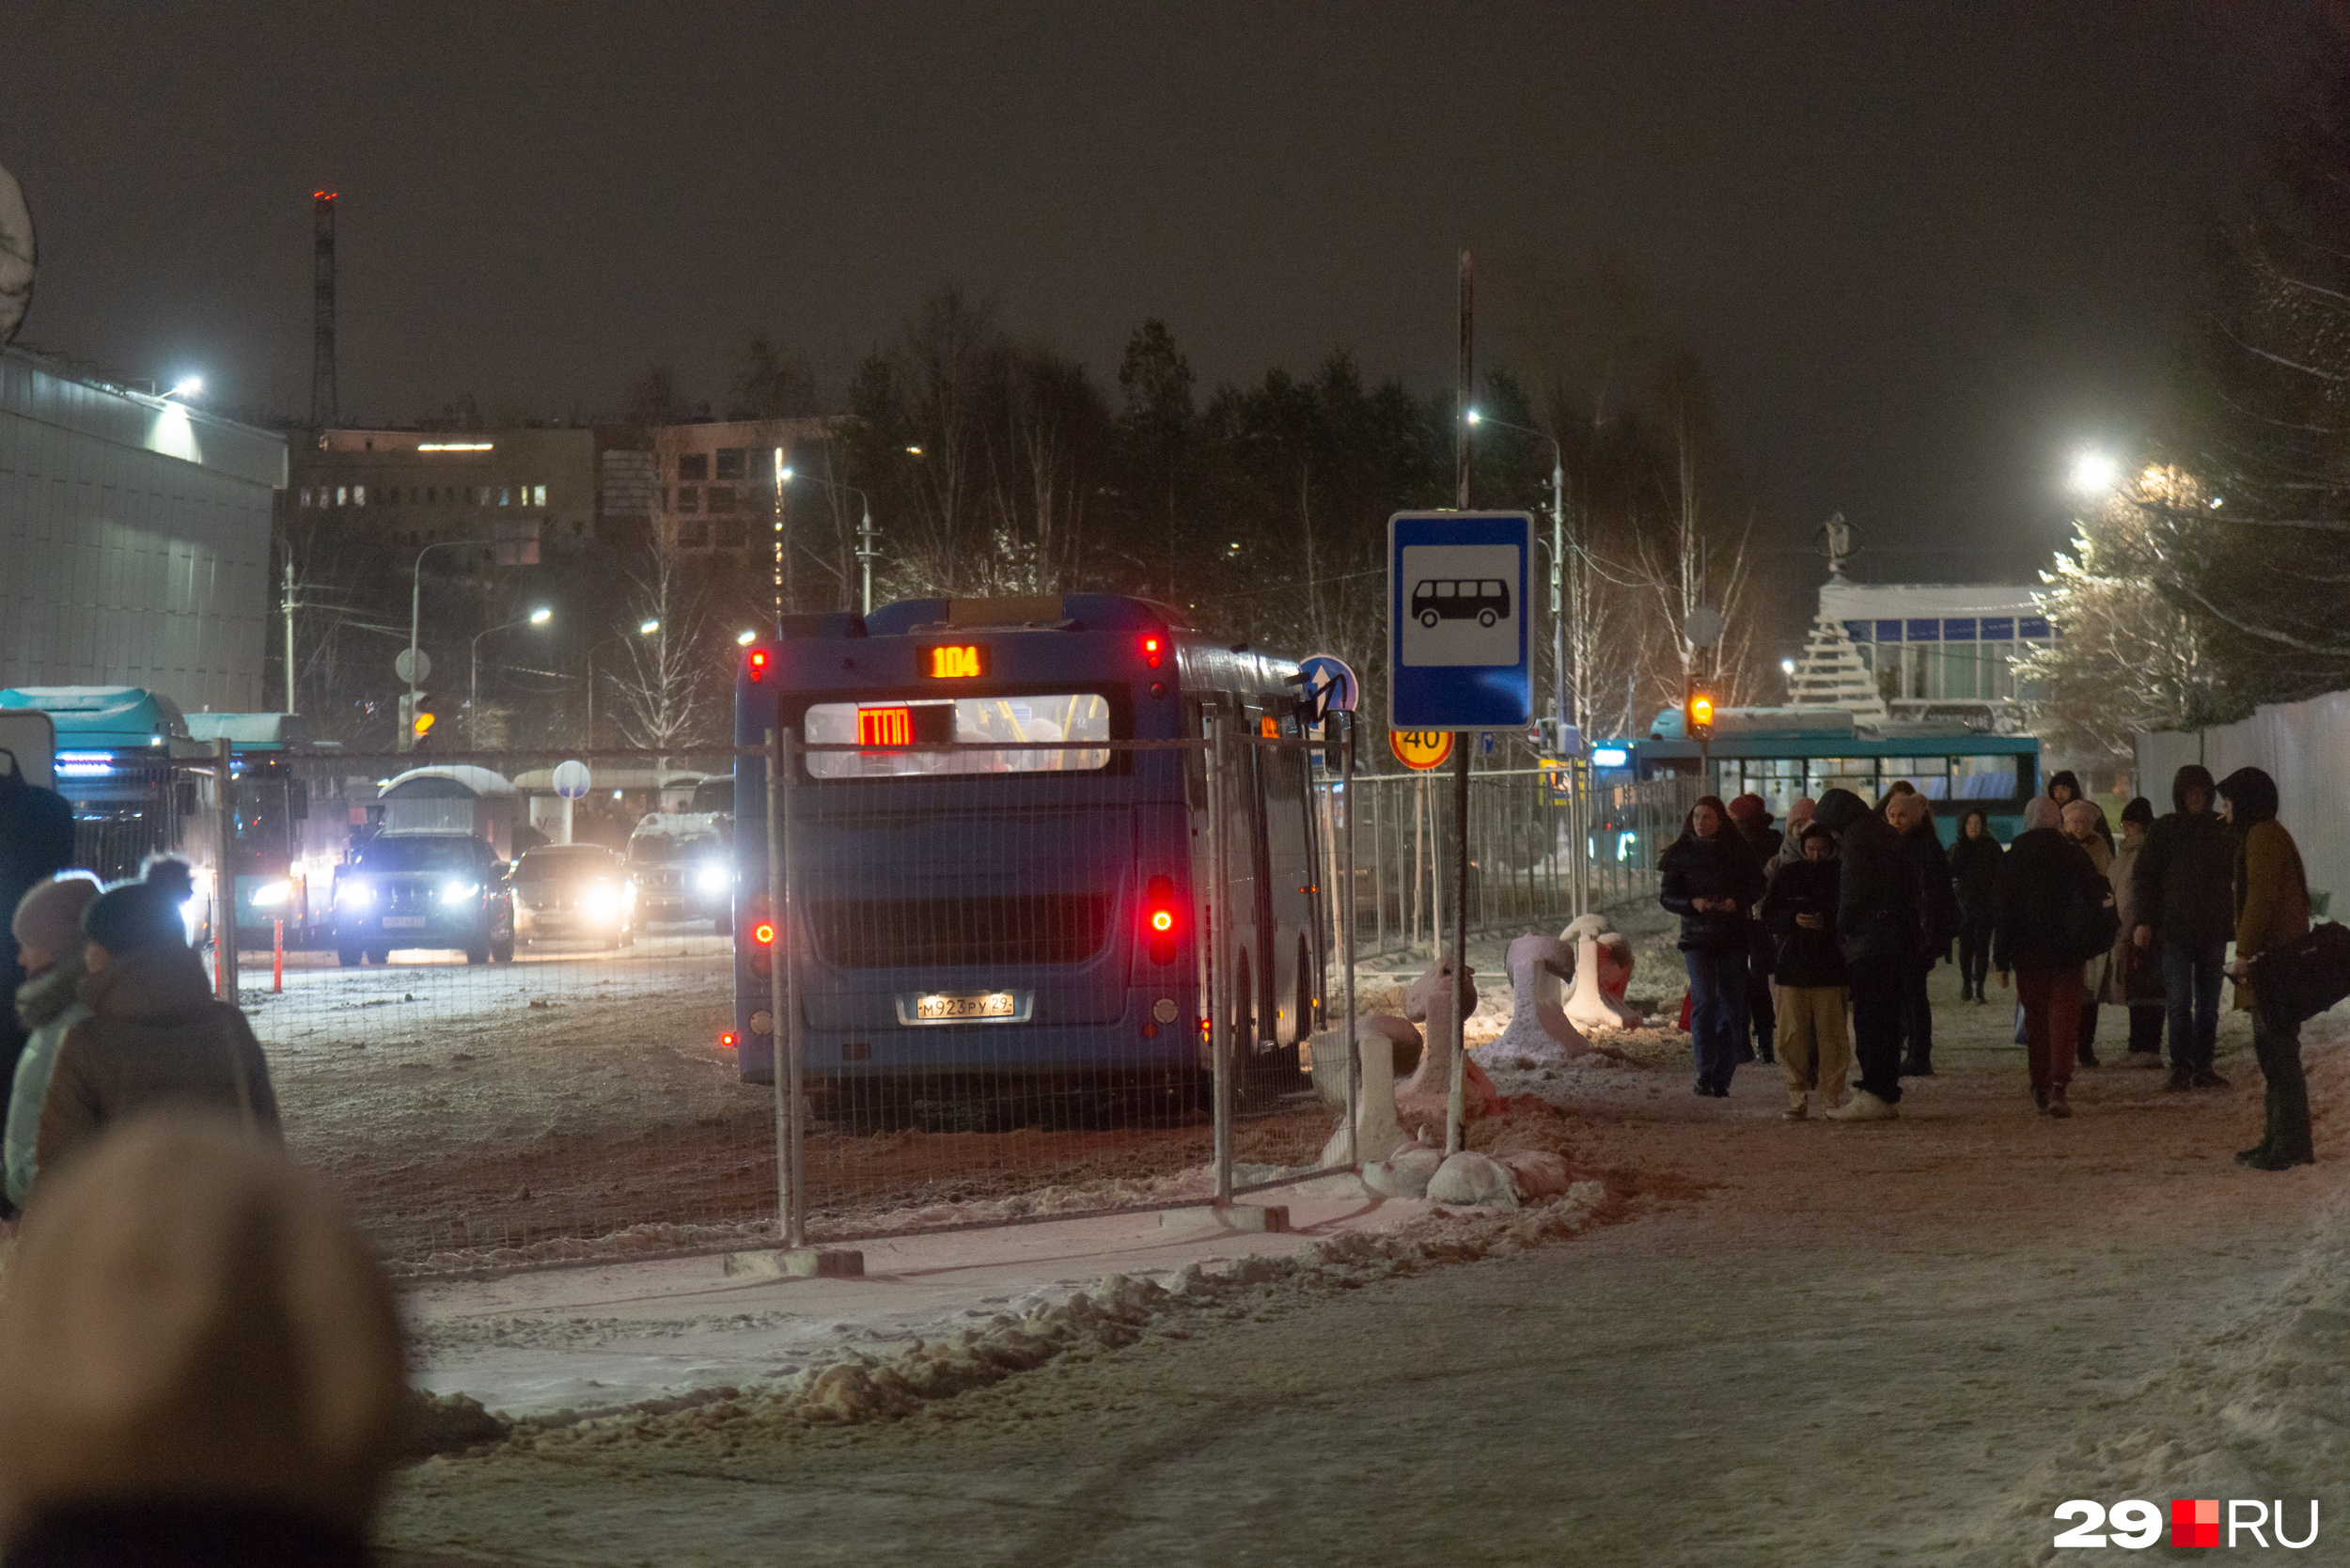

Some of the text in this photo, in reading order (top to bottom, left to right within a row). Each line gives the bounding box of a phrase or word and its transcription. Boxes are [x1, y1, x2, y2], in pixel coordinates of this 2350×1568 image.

[932, 646, 979, 679] 104
[1403, 731, 1440, 749] 40
[992, 996, 1008, 1010] 29
